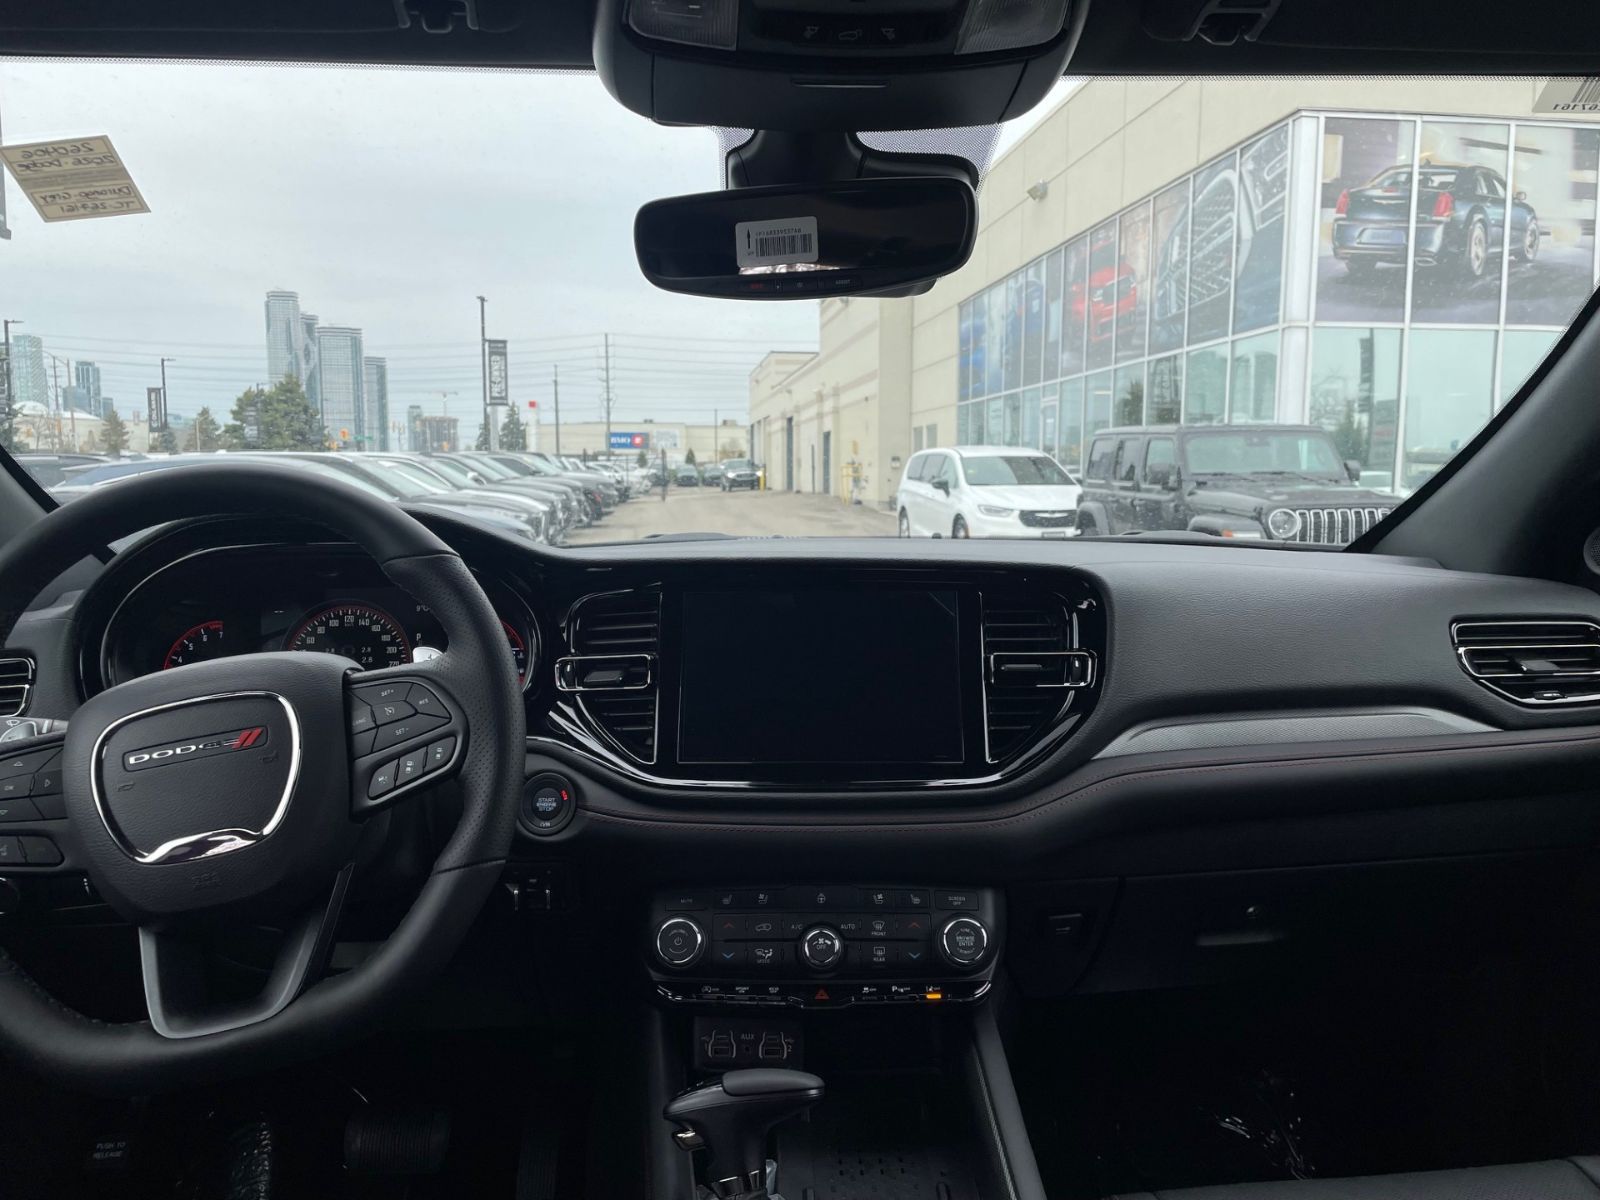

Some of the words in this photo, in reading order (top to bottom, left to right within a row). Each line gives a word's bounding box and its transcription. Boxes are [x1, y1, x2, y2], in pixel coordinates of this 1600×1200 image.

[329, 619, 340, 627] 100
[344, 615, 355, 623] 120
[358, 618, 370, 626] 140
[218, 631, 224, 639] 7
[188, 642, 193, 651] 5
[128, 738, 241, 765] DODGE
